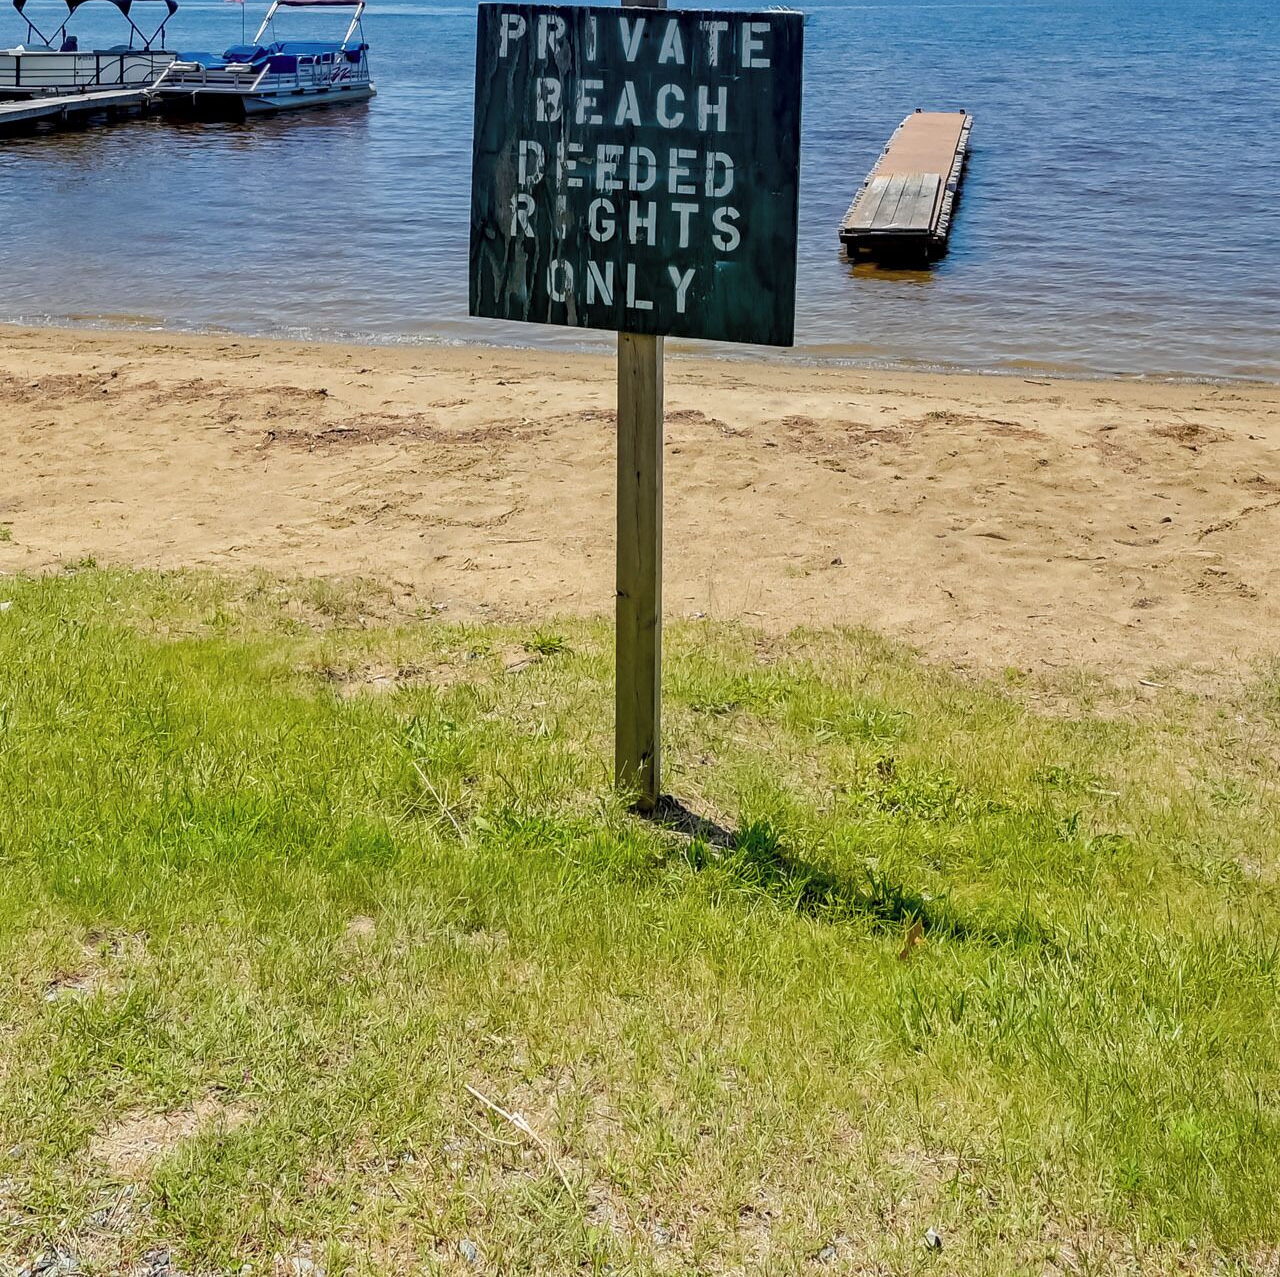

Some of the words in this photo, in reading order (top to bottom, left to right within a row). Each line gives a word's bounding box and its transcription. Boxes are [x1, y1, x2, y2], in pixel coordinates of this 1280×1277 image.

[498, 13, 771, 68] PRIVATE
[535, 77, 728, 132] BEACH
[517, 140, 735, 197] DEEDED
[509, 193, 741, 252] RIGHTS
[546, 259, 696, 314] ONLY
